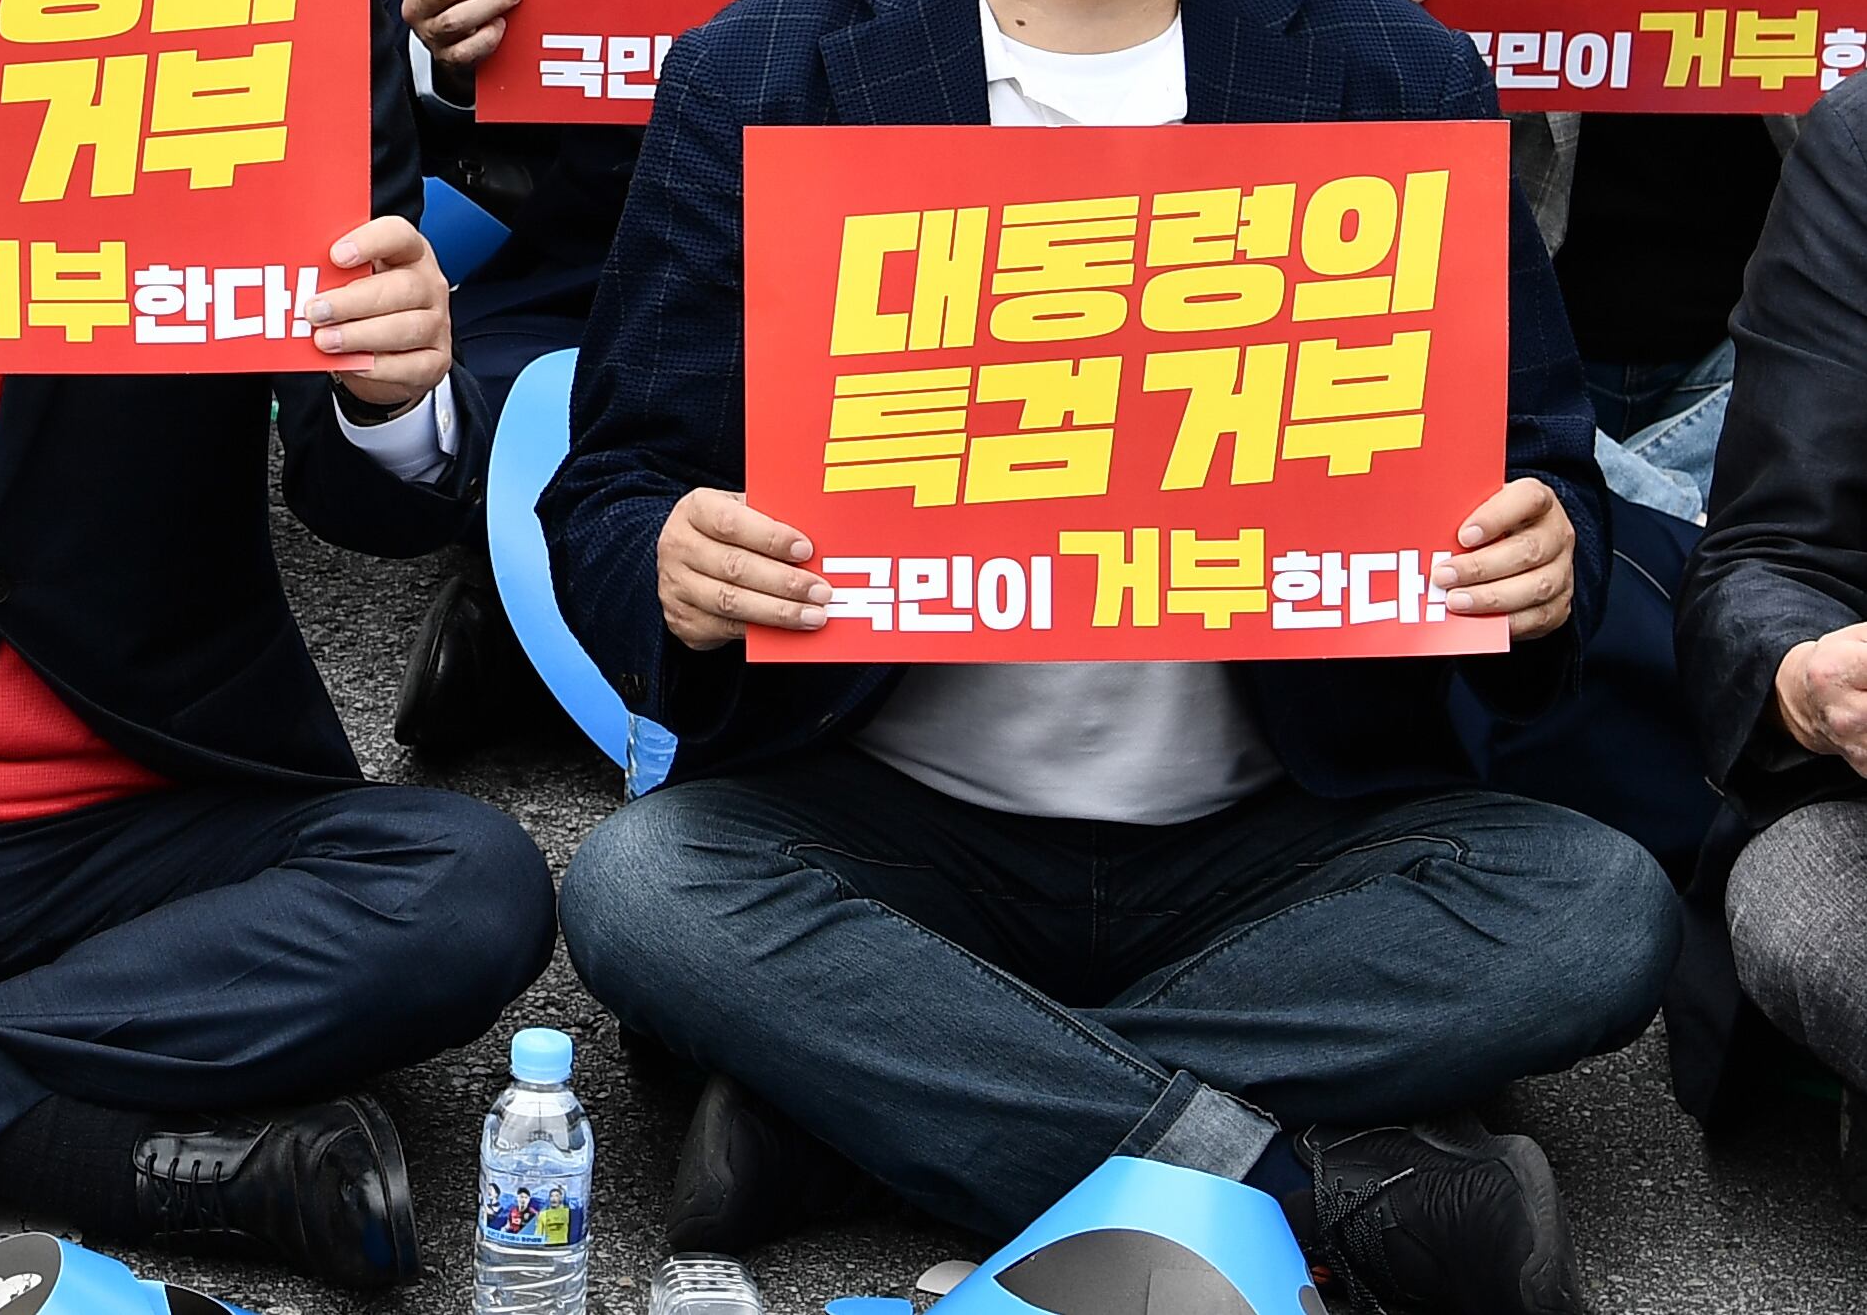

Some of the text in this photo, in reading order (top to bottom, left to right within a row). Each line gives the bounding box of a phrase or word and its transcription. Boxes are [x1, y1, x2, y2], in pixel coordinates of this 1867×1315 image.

[1, 41, 294, 204] 거부
[829, 170, 1450, 357] 대통령의
[822, 330, 1432, 509] 특검 거부
[824, 528, 1454, 633] 국민이 거부한다!
